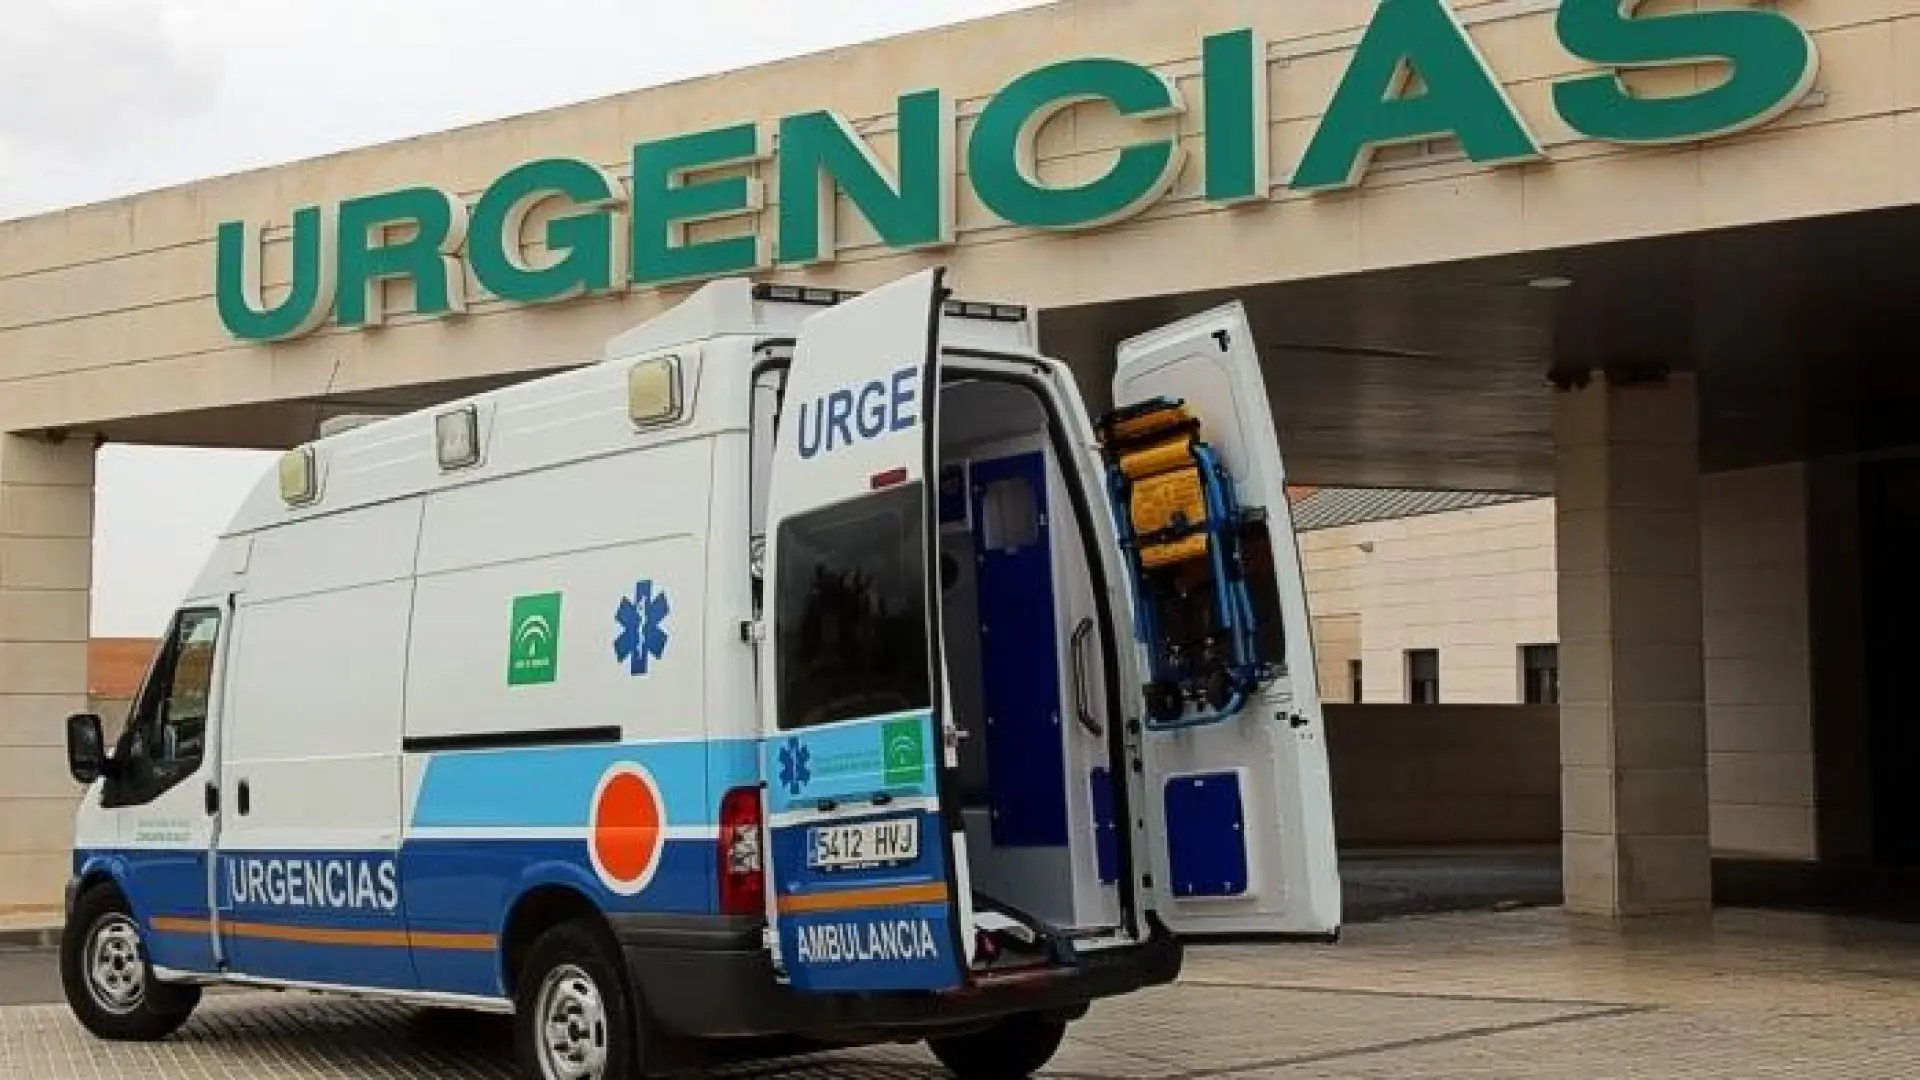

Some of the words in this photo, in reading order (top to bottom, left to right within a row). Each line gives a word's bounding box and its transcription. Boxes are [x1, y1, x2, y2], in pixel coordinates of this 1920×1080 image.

[215, 0, 1820, 344] URGENCIAS
[798, 367, 918, 459] URGE
[818, 829, 863, 861] 5412
[875, 823, 913, 856] HVJ
[229, 858, 399, 909] URGENCIAS
[797, 917, 939, 963] AMBULANCIA
